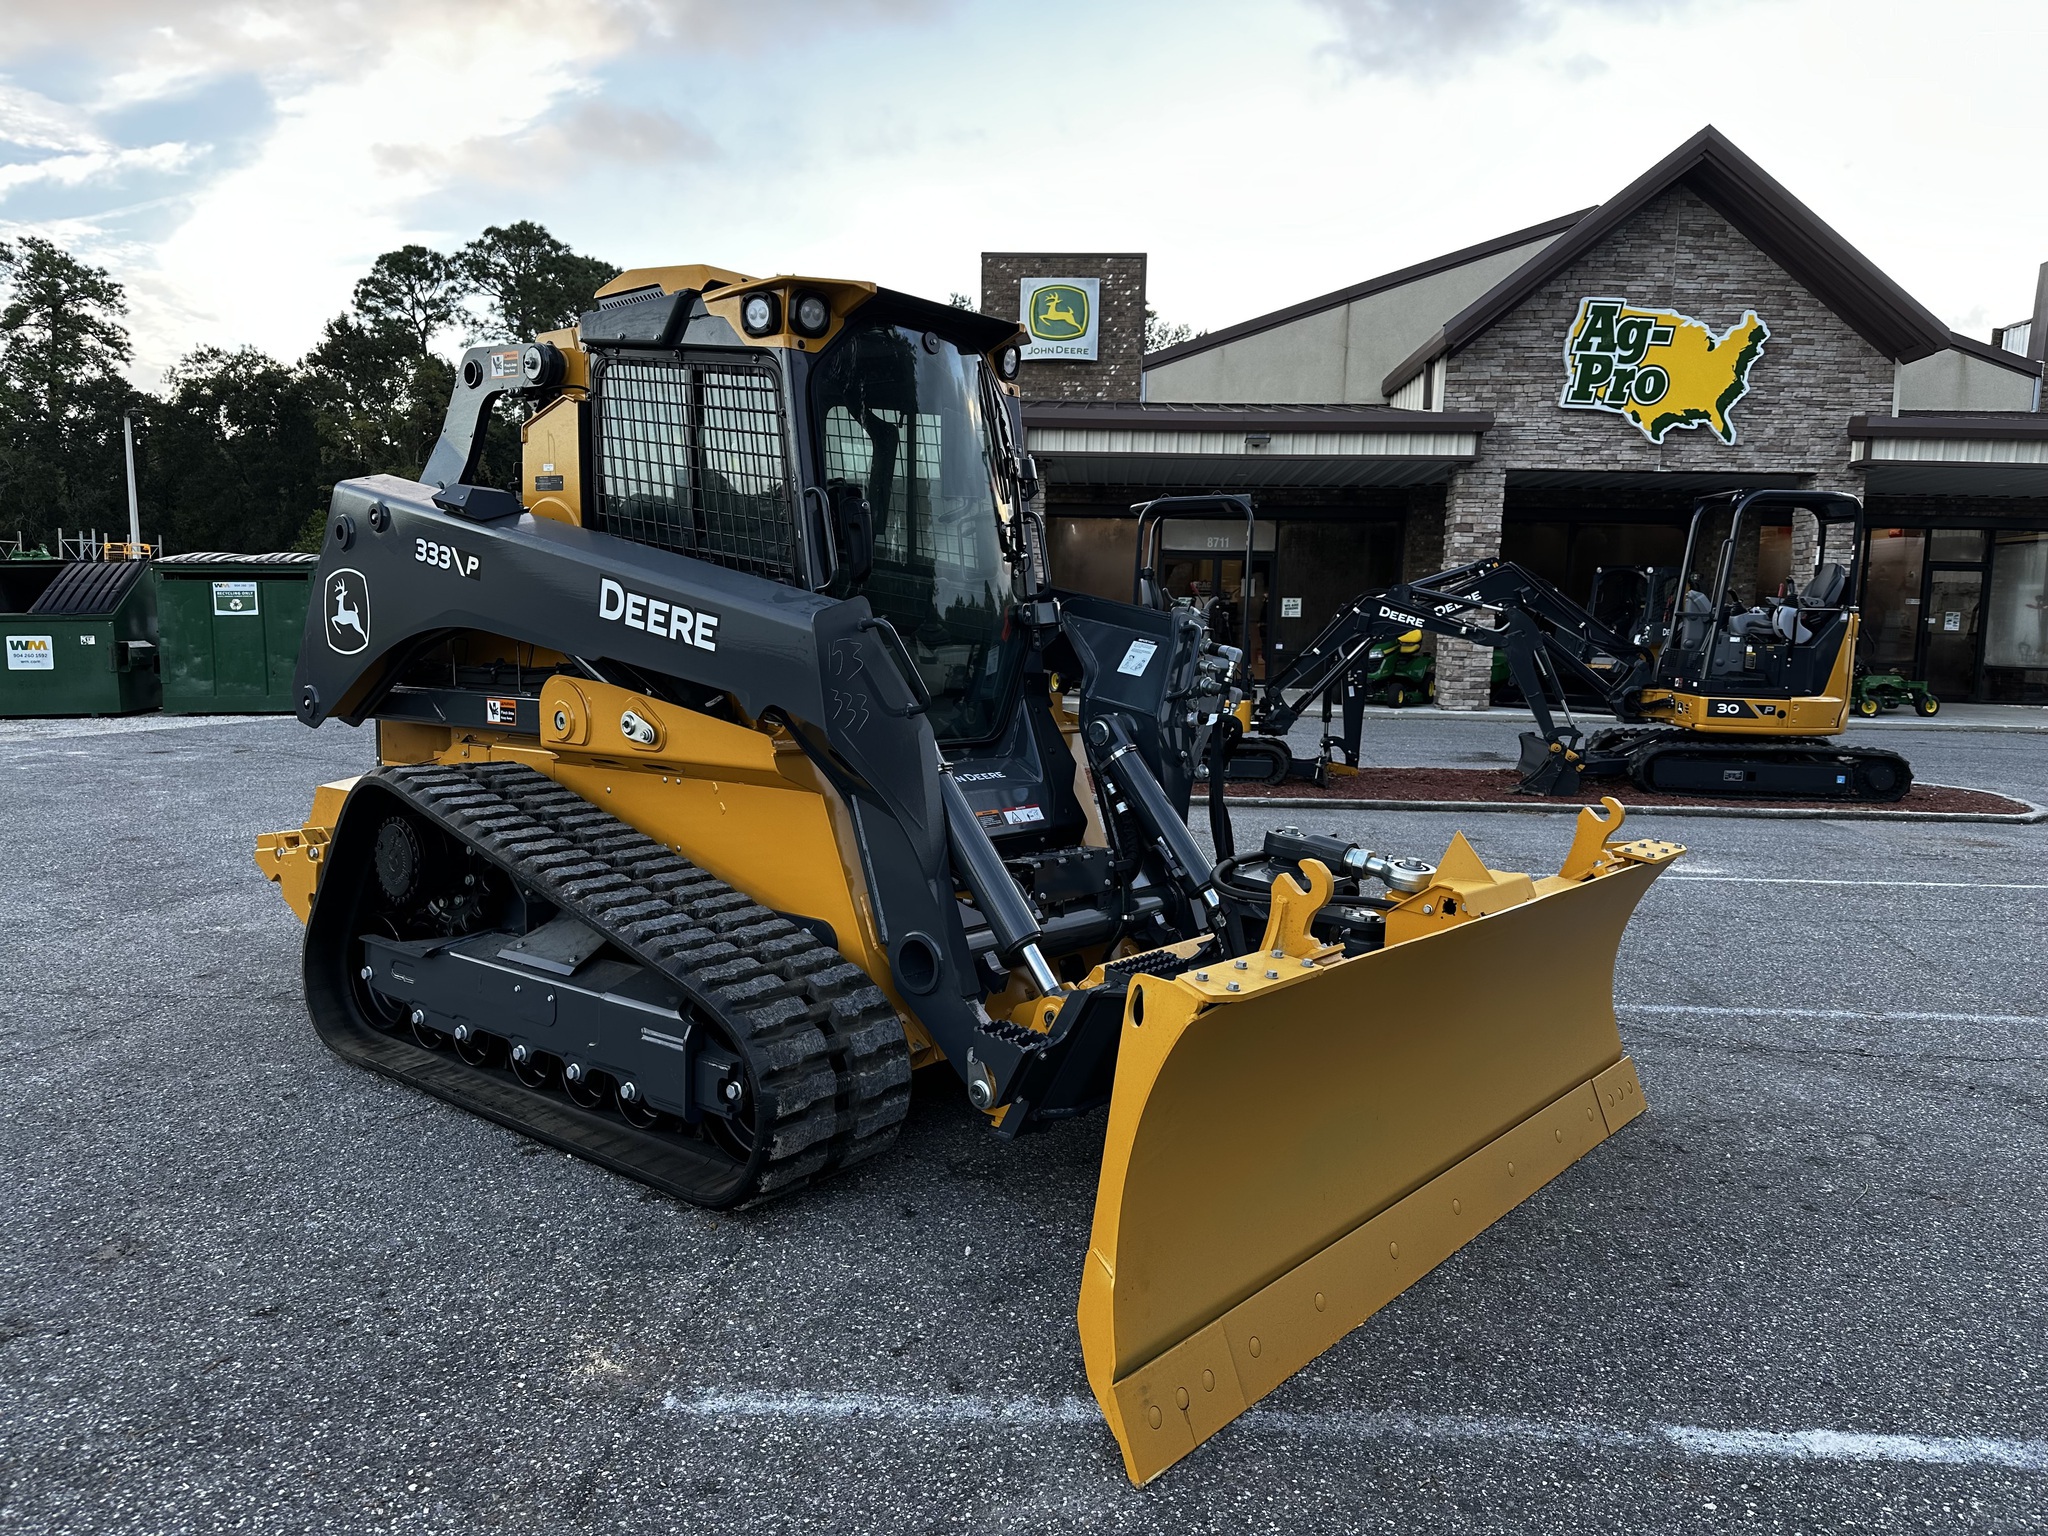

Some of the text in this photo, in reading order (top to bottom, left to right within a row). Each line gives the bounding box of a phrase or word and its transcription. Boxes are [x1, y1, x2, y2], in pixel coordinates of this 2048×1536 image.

[1570, 301, 1676, 366] Ag-
[1028, 345, 1089, 355] JOHN DEERE
[1566, 353, 1670, 405] Pro
[1207, 536, 1229, 548] 8711
[600, 578, 718, 652] DEERE
[1379, 606, 1425, 628] DEERE
[9, 640, 48, 650] WM
[830, 688, 870, 734] 333
[1717, 703, 1775, 715] 30 P
[964, 771, 1007, 782] DEERE
